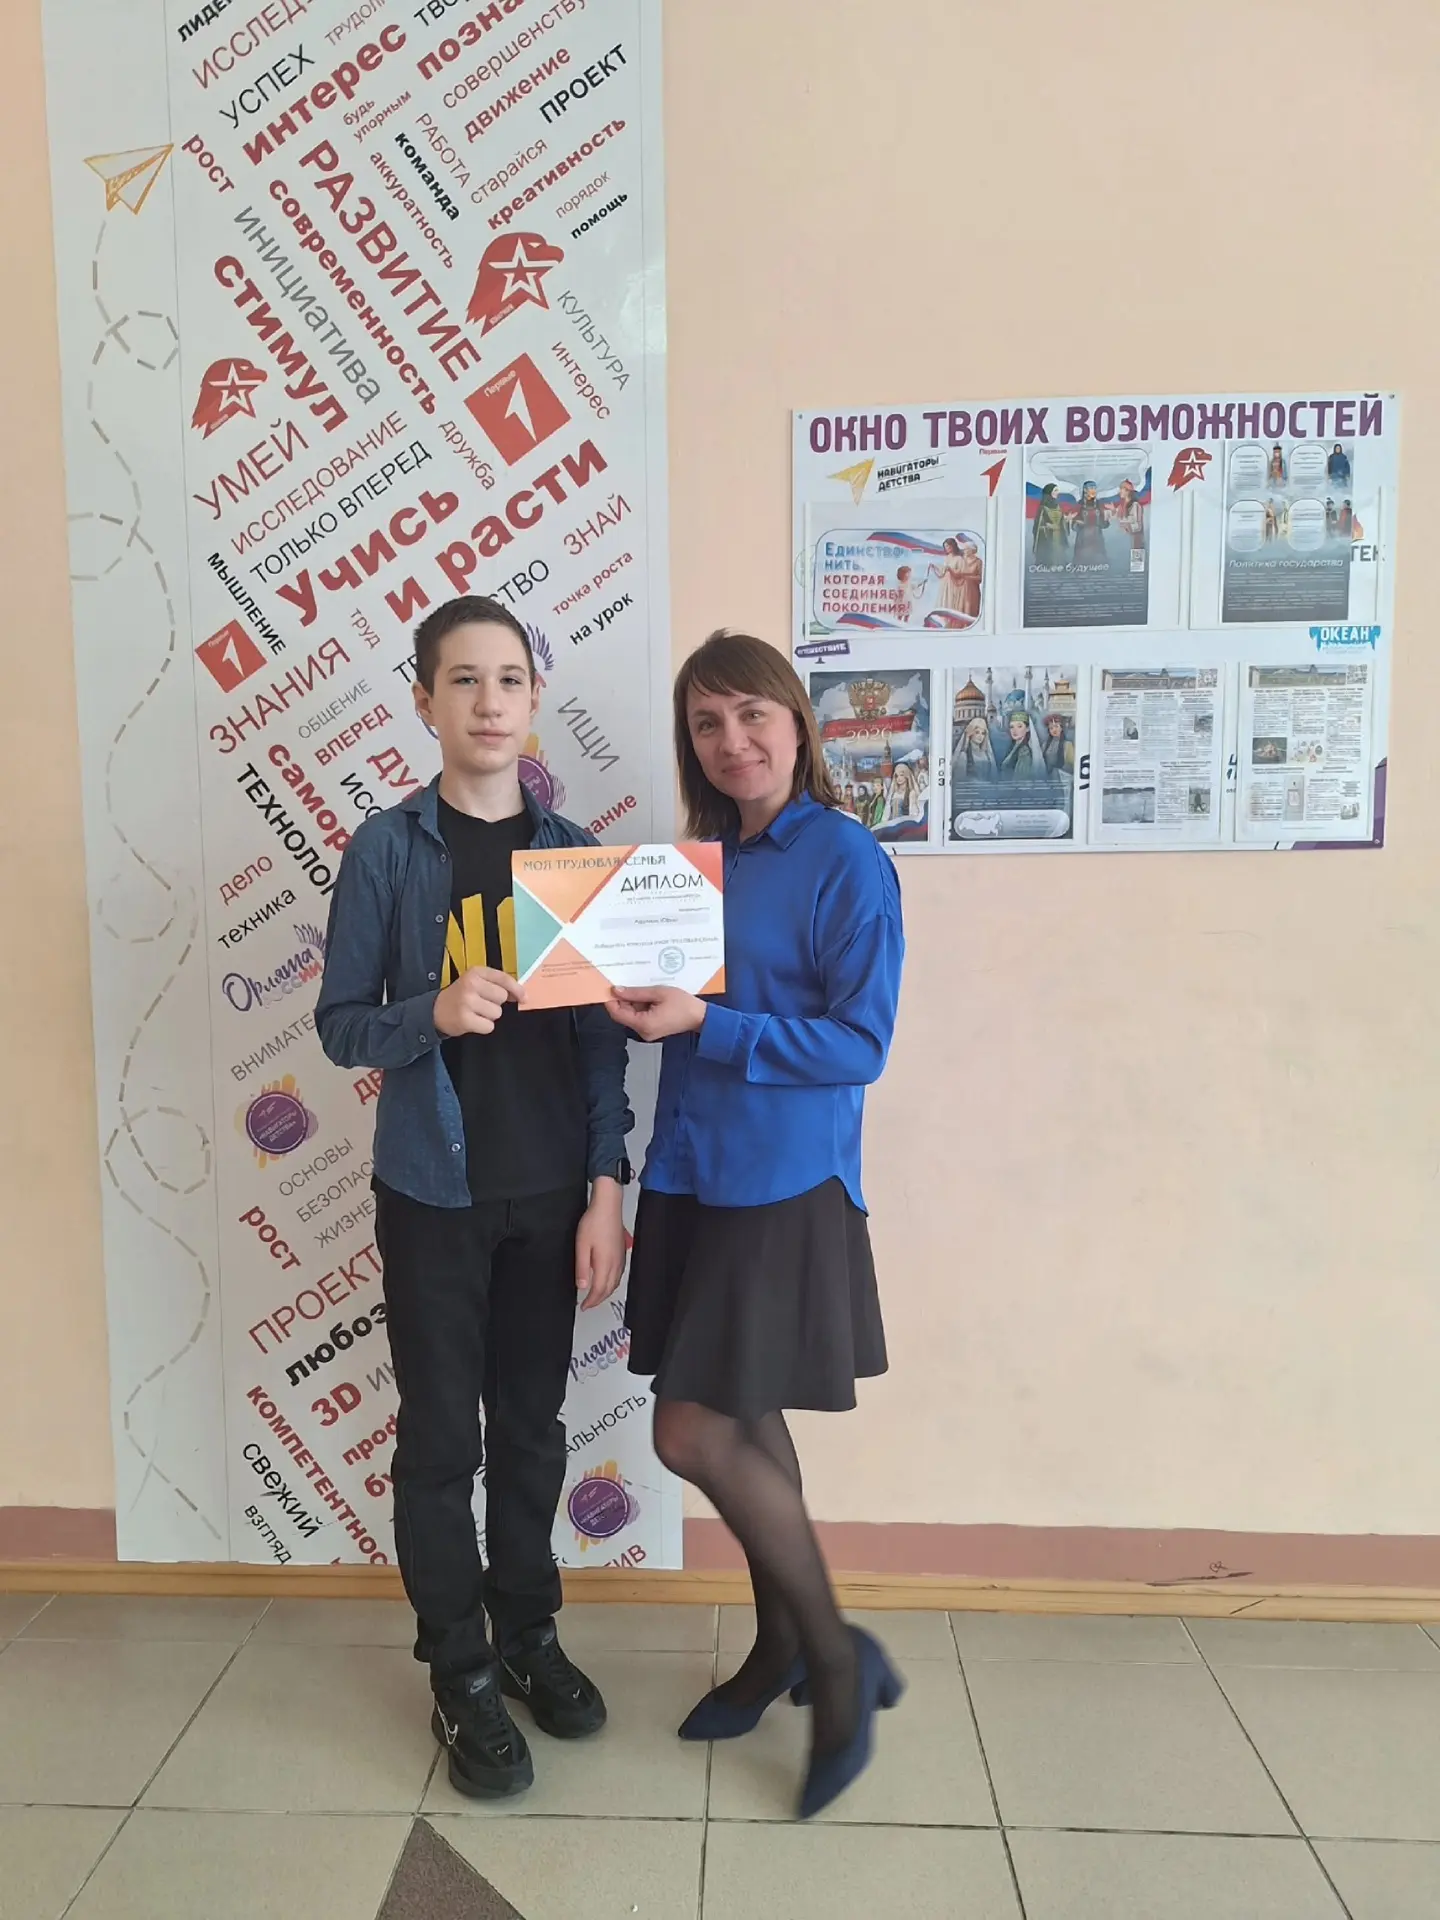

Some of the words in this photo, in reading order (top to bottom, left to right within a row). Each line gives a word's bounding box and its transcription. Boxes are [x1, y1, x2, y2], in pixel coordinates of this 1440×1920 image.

[219, 44, 315, 128] УСПЕХ
[242, 23, 407, 166] интерес
[343, 97, 375, 126] будь
[353, 90, 412, 142] упорным
[464, 48, 571, 143] движение
[539, 44, 629, 123] ПРОЕКТ
[181, 134, 234, 194] рост
[394, 132, 460, 222] команда
[416, 113, 472, 188] РАБОТА
[470, 139, 548, 204] старайся
[487, 118, 626, 230] креативность
[369, 151, 453, 270] аккуратность
[555, 170, 611, 220] порядок
[569, 192, 628, 240] помощь
[299, 140, 481, 381] РАЗВИТИЕ
[234, 206, 380, 405] инициатива
[269, 180, 436, 415] современность
[214, 255, 348, 433] стимул
[556, 290, 631, 391] КУЛЬТУРА
[551, 341, 610, 420] интерес
[438, 419, 496, 491] дружба
[809, 413, 907, 455] ОКНО
[923, 406, 1049, 448] ТВОИХ
[1065, 392, 1382, 443] ВОЗМОЖНОСТЕЙ
[192, 418, 310, 520] УМЕЙ
[231, 410, 407, 555] ИССЛЕДОВАНИЕ
[249, 512, 338, 584] ТОЛЬКО
[338, 441, 432, 518] ВПЕРЕД
[384, 576, 431, 624] и
[435, 438, 608, 594] расти
[563, 494, 633, 556] ЗНАЙ
[275, 490, 459, 627] Учись
[488, 560, 549, 604] ТВО
[552, 583, 591, 617] точка
[592, 550, 634, 588] роста
[824, 575, 885, 585] КОТОРАЯ
[207, 552, 286, 656] МЫШЛЕНИЕ
[350, 607, 381, 649] труд
[569, 622, 592, 646] на
[592, 591, 634, 633] урок
[1320, 626, 1369, 641] ОКЕАН
[209, 637, 350, 754] ЗНАНИЯ
[298, 679, 373, 740] ОБЩЕНИЕ
[315, 703, 393, 766] ВПЕРЕД
[557, 696, 620, 772] ИЩИ
[268, 744, 353, 851] самор
[366, 746, 422, 800] ДУ
[219, 855, 273, 905] дело
[523, 860, 552, 871] МОЯ
[621, 873, 703, 893] ДИПЛОМ
[217, 887, 296, 950] техника
[231, 1013, 315, 1081] ВНИМАТЕ
[279, 1138, 354, 1196] ОСНОВЫ
[238, 1205, 302, 1273] рост
[248, 1242, 383, 1354] ПРОЕКТ
[310, 1381, 362, 1426] 3D
[242, 1442, 325, 1540] свежий
[244, 1505, 293, 1564] взгляд
